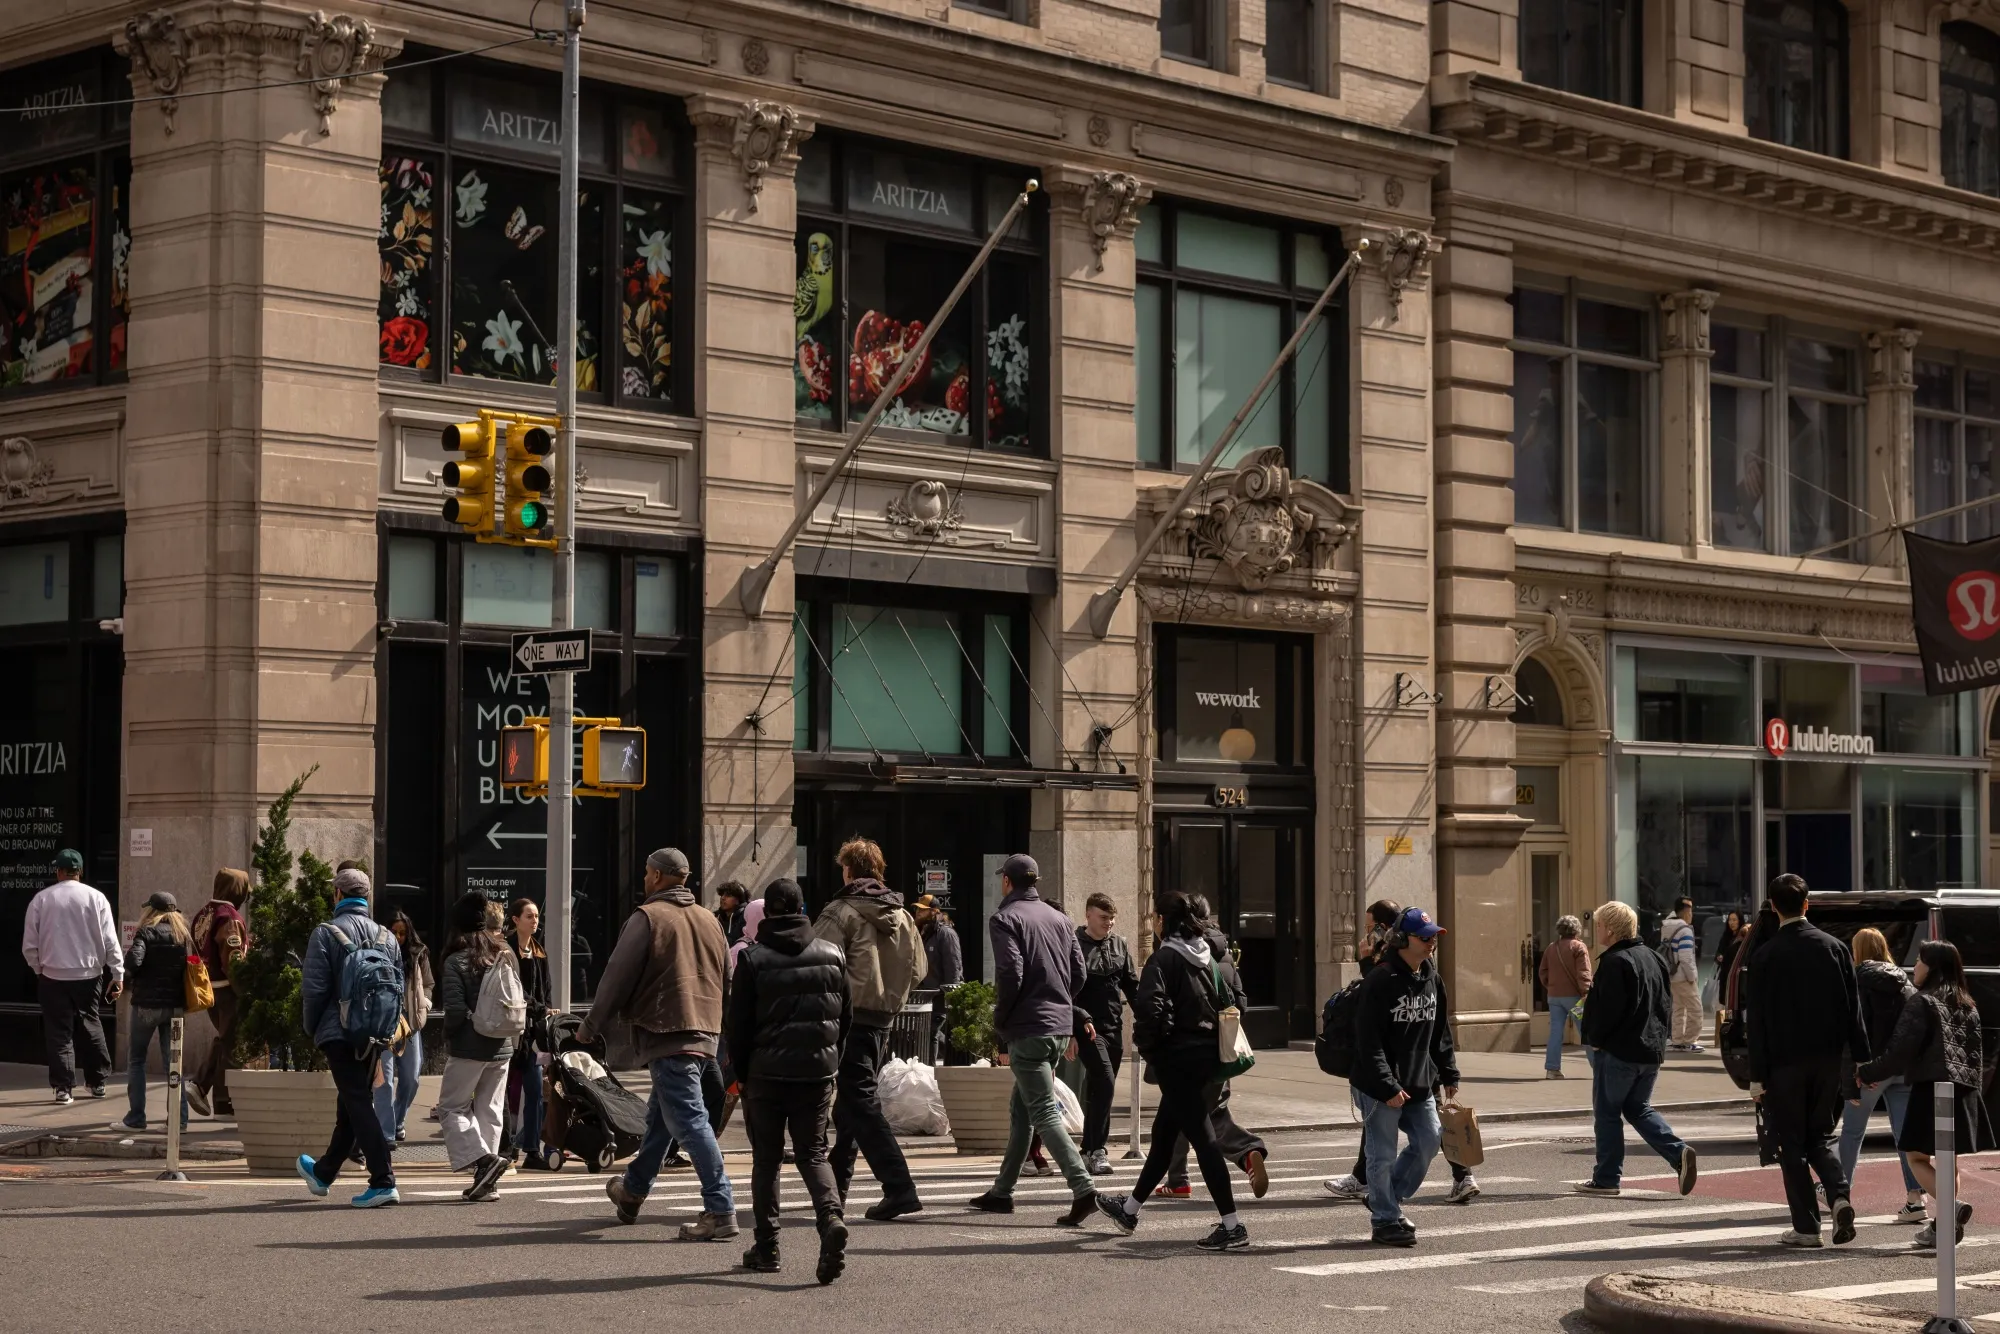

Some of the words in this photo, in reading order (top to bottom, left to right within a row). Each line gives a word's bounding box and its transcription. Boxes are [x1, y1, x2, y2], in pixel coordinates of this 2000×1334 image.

[19, 84, 85, 122] ARITZIA
[482, 108, 562, 145] ARITZI
[872, 181, 949, 216] ARITZIA
[1518, 584, 1540, 604] 20
[1565, 587, 1595, 610] 522
[523, 645, 545, 661] ONE
[555, 642, 580, 660] WAY
[1936, 656, 2000, 685] lulule
[1195, 687, 1261, 708] wework
[1792, 724, 1874, 755] lululemon
[0, 741, 66, 775] RITZIA
[1219, 787, 1245, 805] 524
[1516, 786, 1534, 803] 20
[0, 807, 13, 819] ND
[14, 807, 25, 819] US
[27, 807, 37, 818] AT
[38, 806, 55, 818] THE
[0, 823, 18, 834] RNER
[20, 823, 31, 834] OF
[33, 822, 63, 834] PRINCE
[0, 839, 10, 850] ND
[12, 839, 57, 850] BROADWAY
[1, 865, 15, 873] new
[16, 863, 47, 876] flagship's
[48, 863, 57, 876] jus
[2, 881, 14, 889] one
[16, 878, 34, 889] block
[467, 877, 484, 886] Find
[500, 889, 509, 898] at
[1395, 992, 1437, 1009] SUICIDA
[1389, 1007, 1437, 1022] TENDENCI
